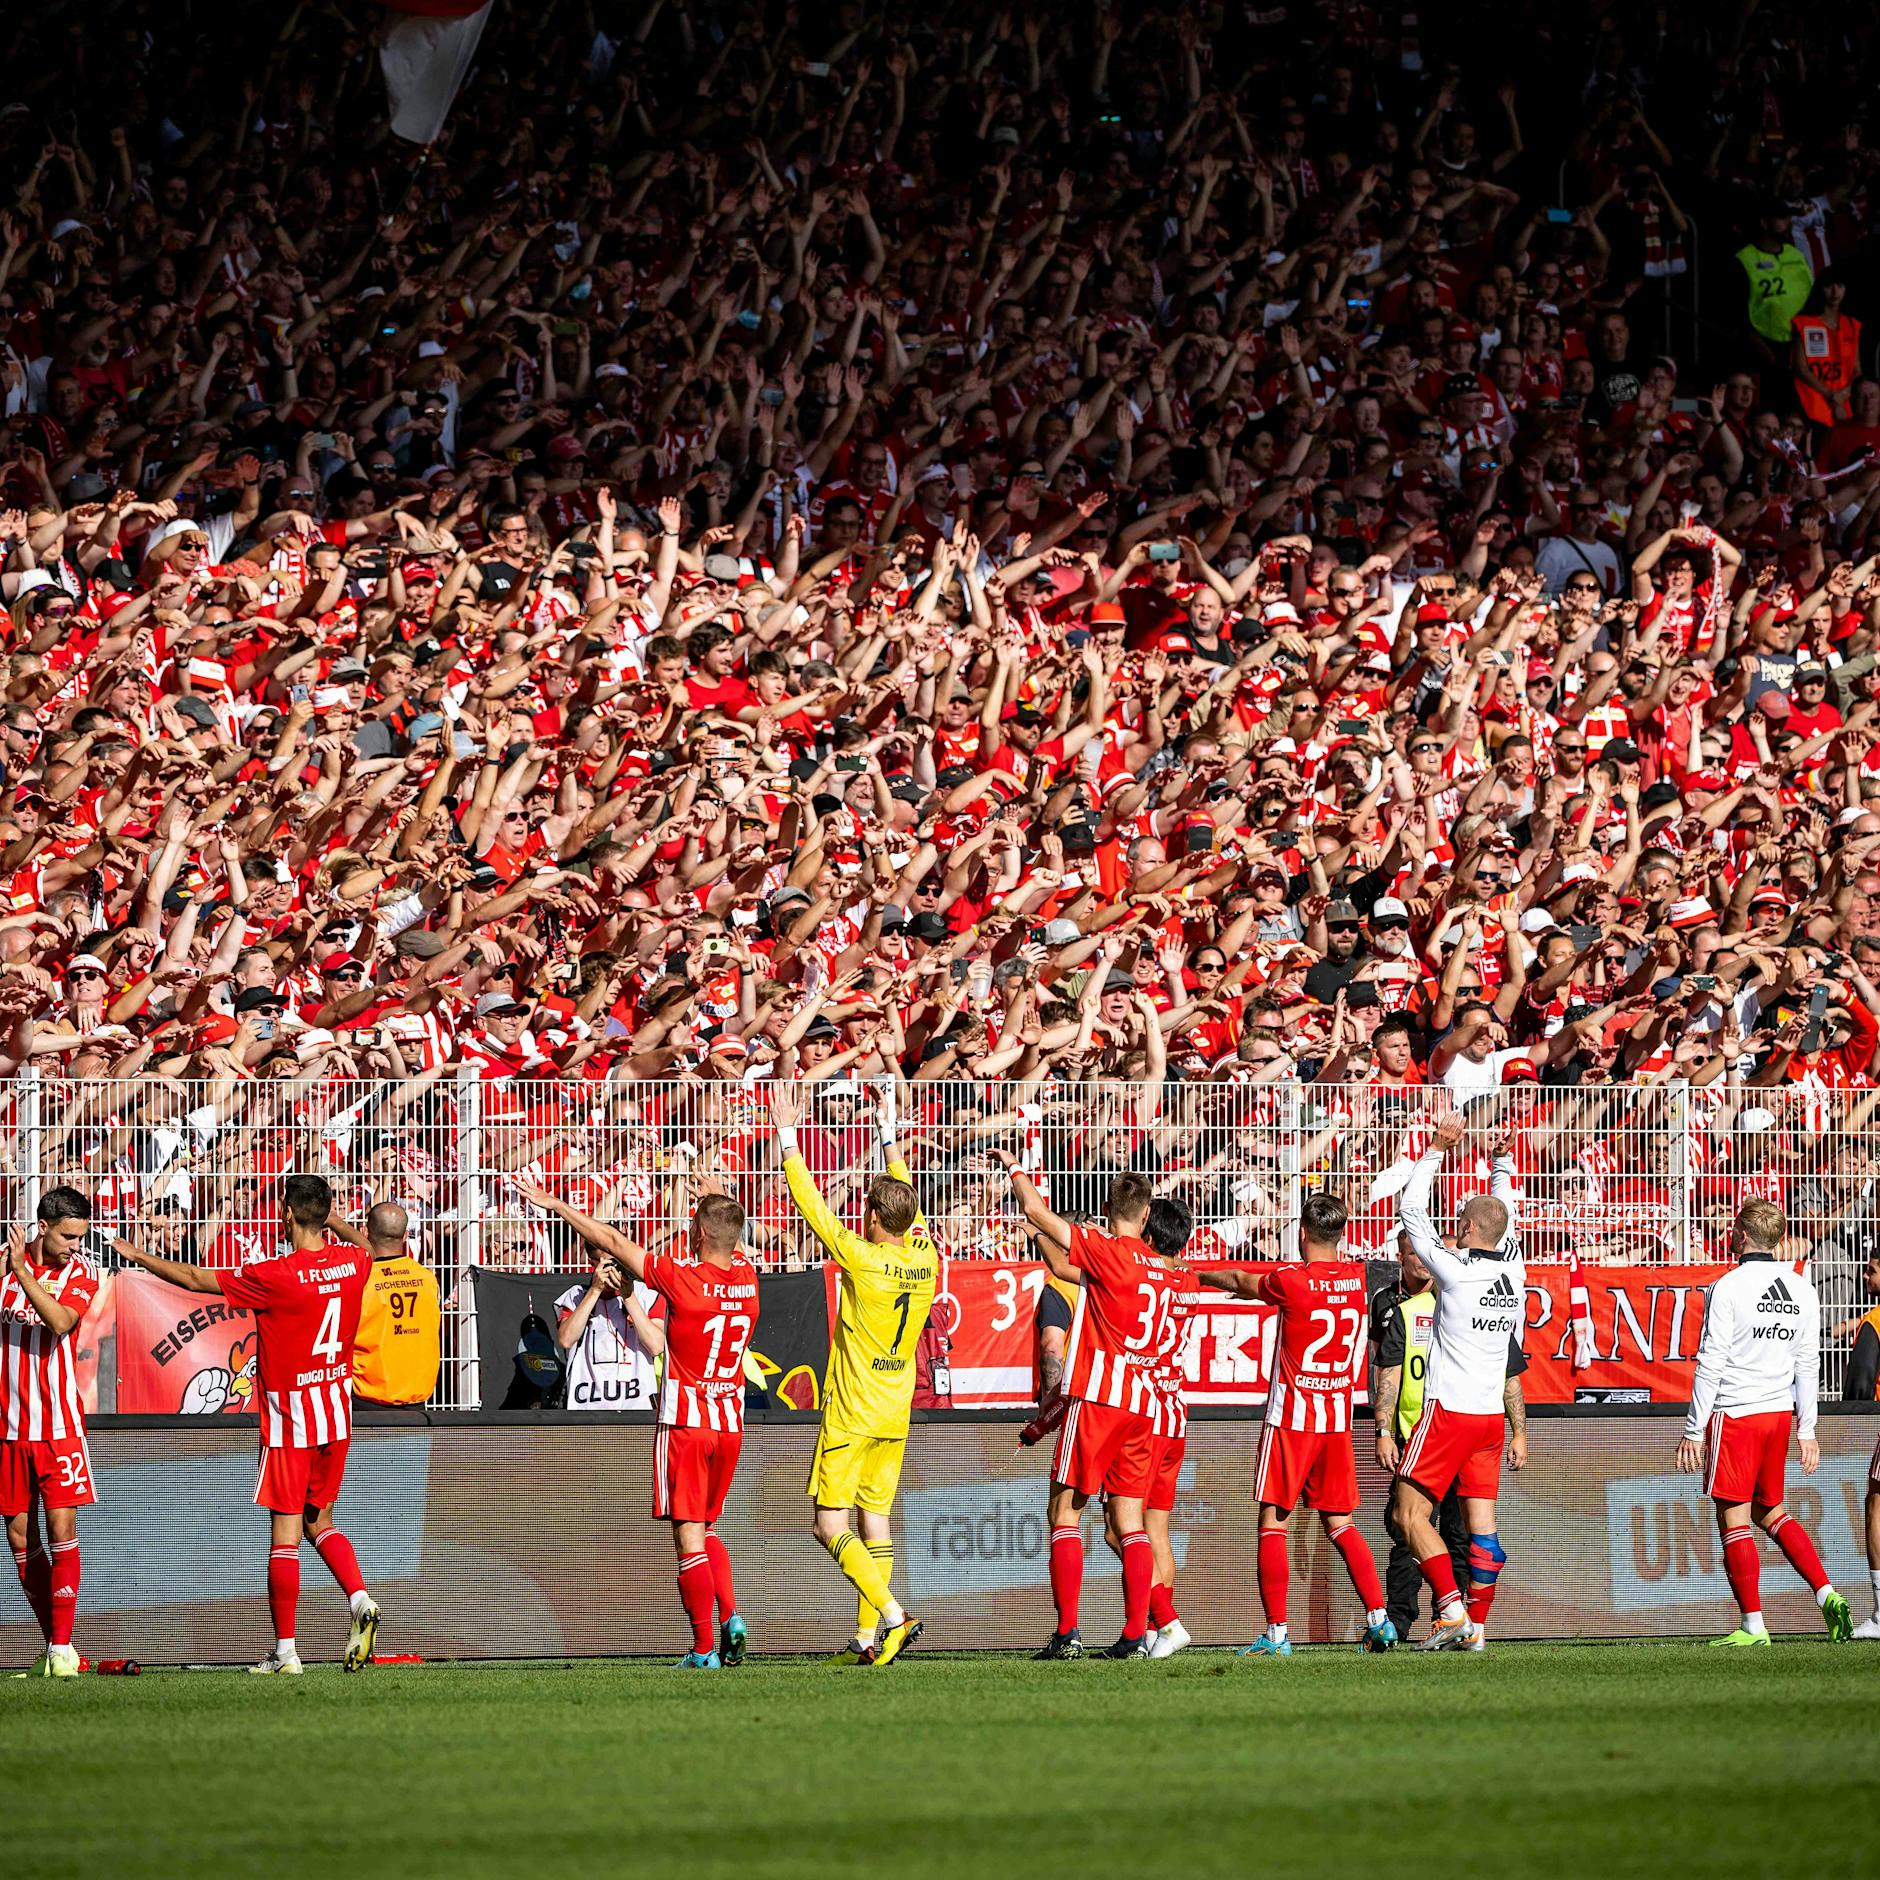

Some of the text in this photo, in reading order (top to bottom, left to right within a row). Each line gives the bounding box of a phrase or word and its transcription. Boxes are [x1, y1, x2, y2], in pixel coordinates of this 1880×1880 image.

[1759, 277, 1786, 298] 22
[321, 1261, 357, 1281] UNION
[905, 1266, 932, 1281] UNION
[374, 1279, 424, 1292] SICHERHEIT
[713, 1283, 726, 1298] FC
[727, 1283, 756, 1299] UNION
[1333, 1277, 1362, 1293] UNION
[389, 1291, 418, 1319] 97
[1479, 1295, 1519, 1308] adidas
[1756, 1300, 1800, 1315] adidas
[893, 1292, 911, 1356] 1
[1123, 1282, 1171, 1351] 31
[311, 1296, 343, 1365] 4
[1301, 1307, 1360, 1374] 23
[1752, 1322, 1798, 1342] wefox
[702, 1314, 751, 1379] 13
[871, 1355, 907, 1371] RÖNNOW
[574, 1378, 641, 1405] CLUB
[56, 1451, 87, 1487] 32
[929, 1500, 1043, 1560] radio
